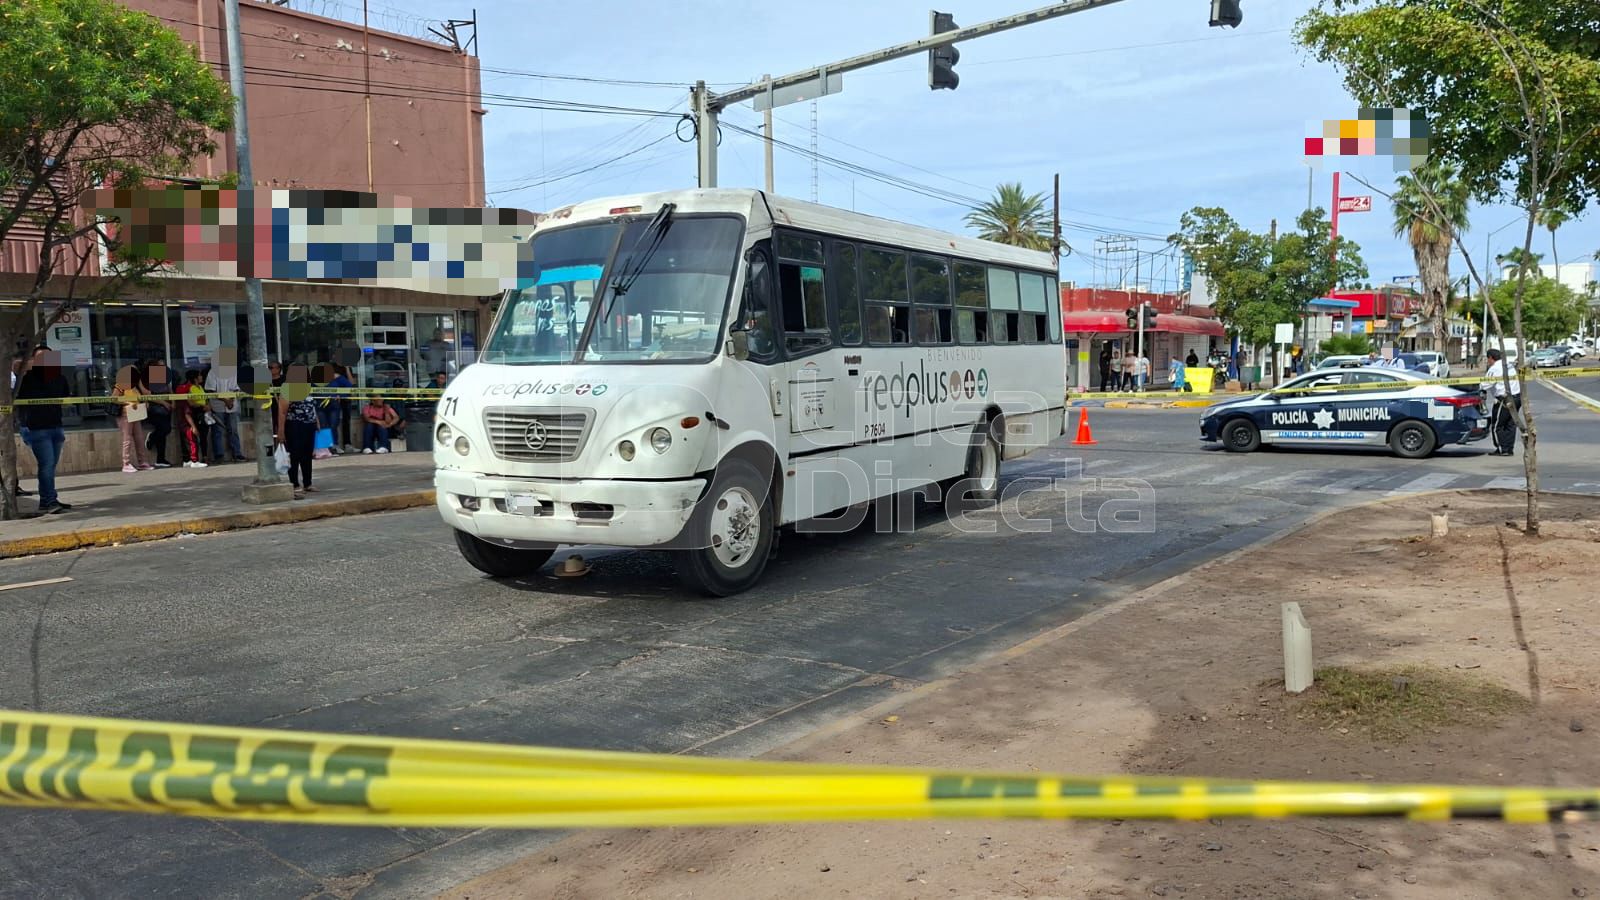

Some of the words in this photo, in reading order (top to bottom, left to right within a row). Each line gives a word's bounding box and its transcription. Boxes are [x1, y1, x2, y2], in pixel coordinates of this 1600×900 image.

[927, 349, 983, 362] BIENVENIDO
[863, 358, 948, 418] redplus
[445, 396, 459, 417] 71
[1271, 408, 1309, 425] POLICÍA
[1337, 405, 1391, 422] MUNICIPAL
[1278, 431, 1309, 439] UNIDAD
[1311, 431, 1323, 439] DE
